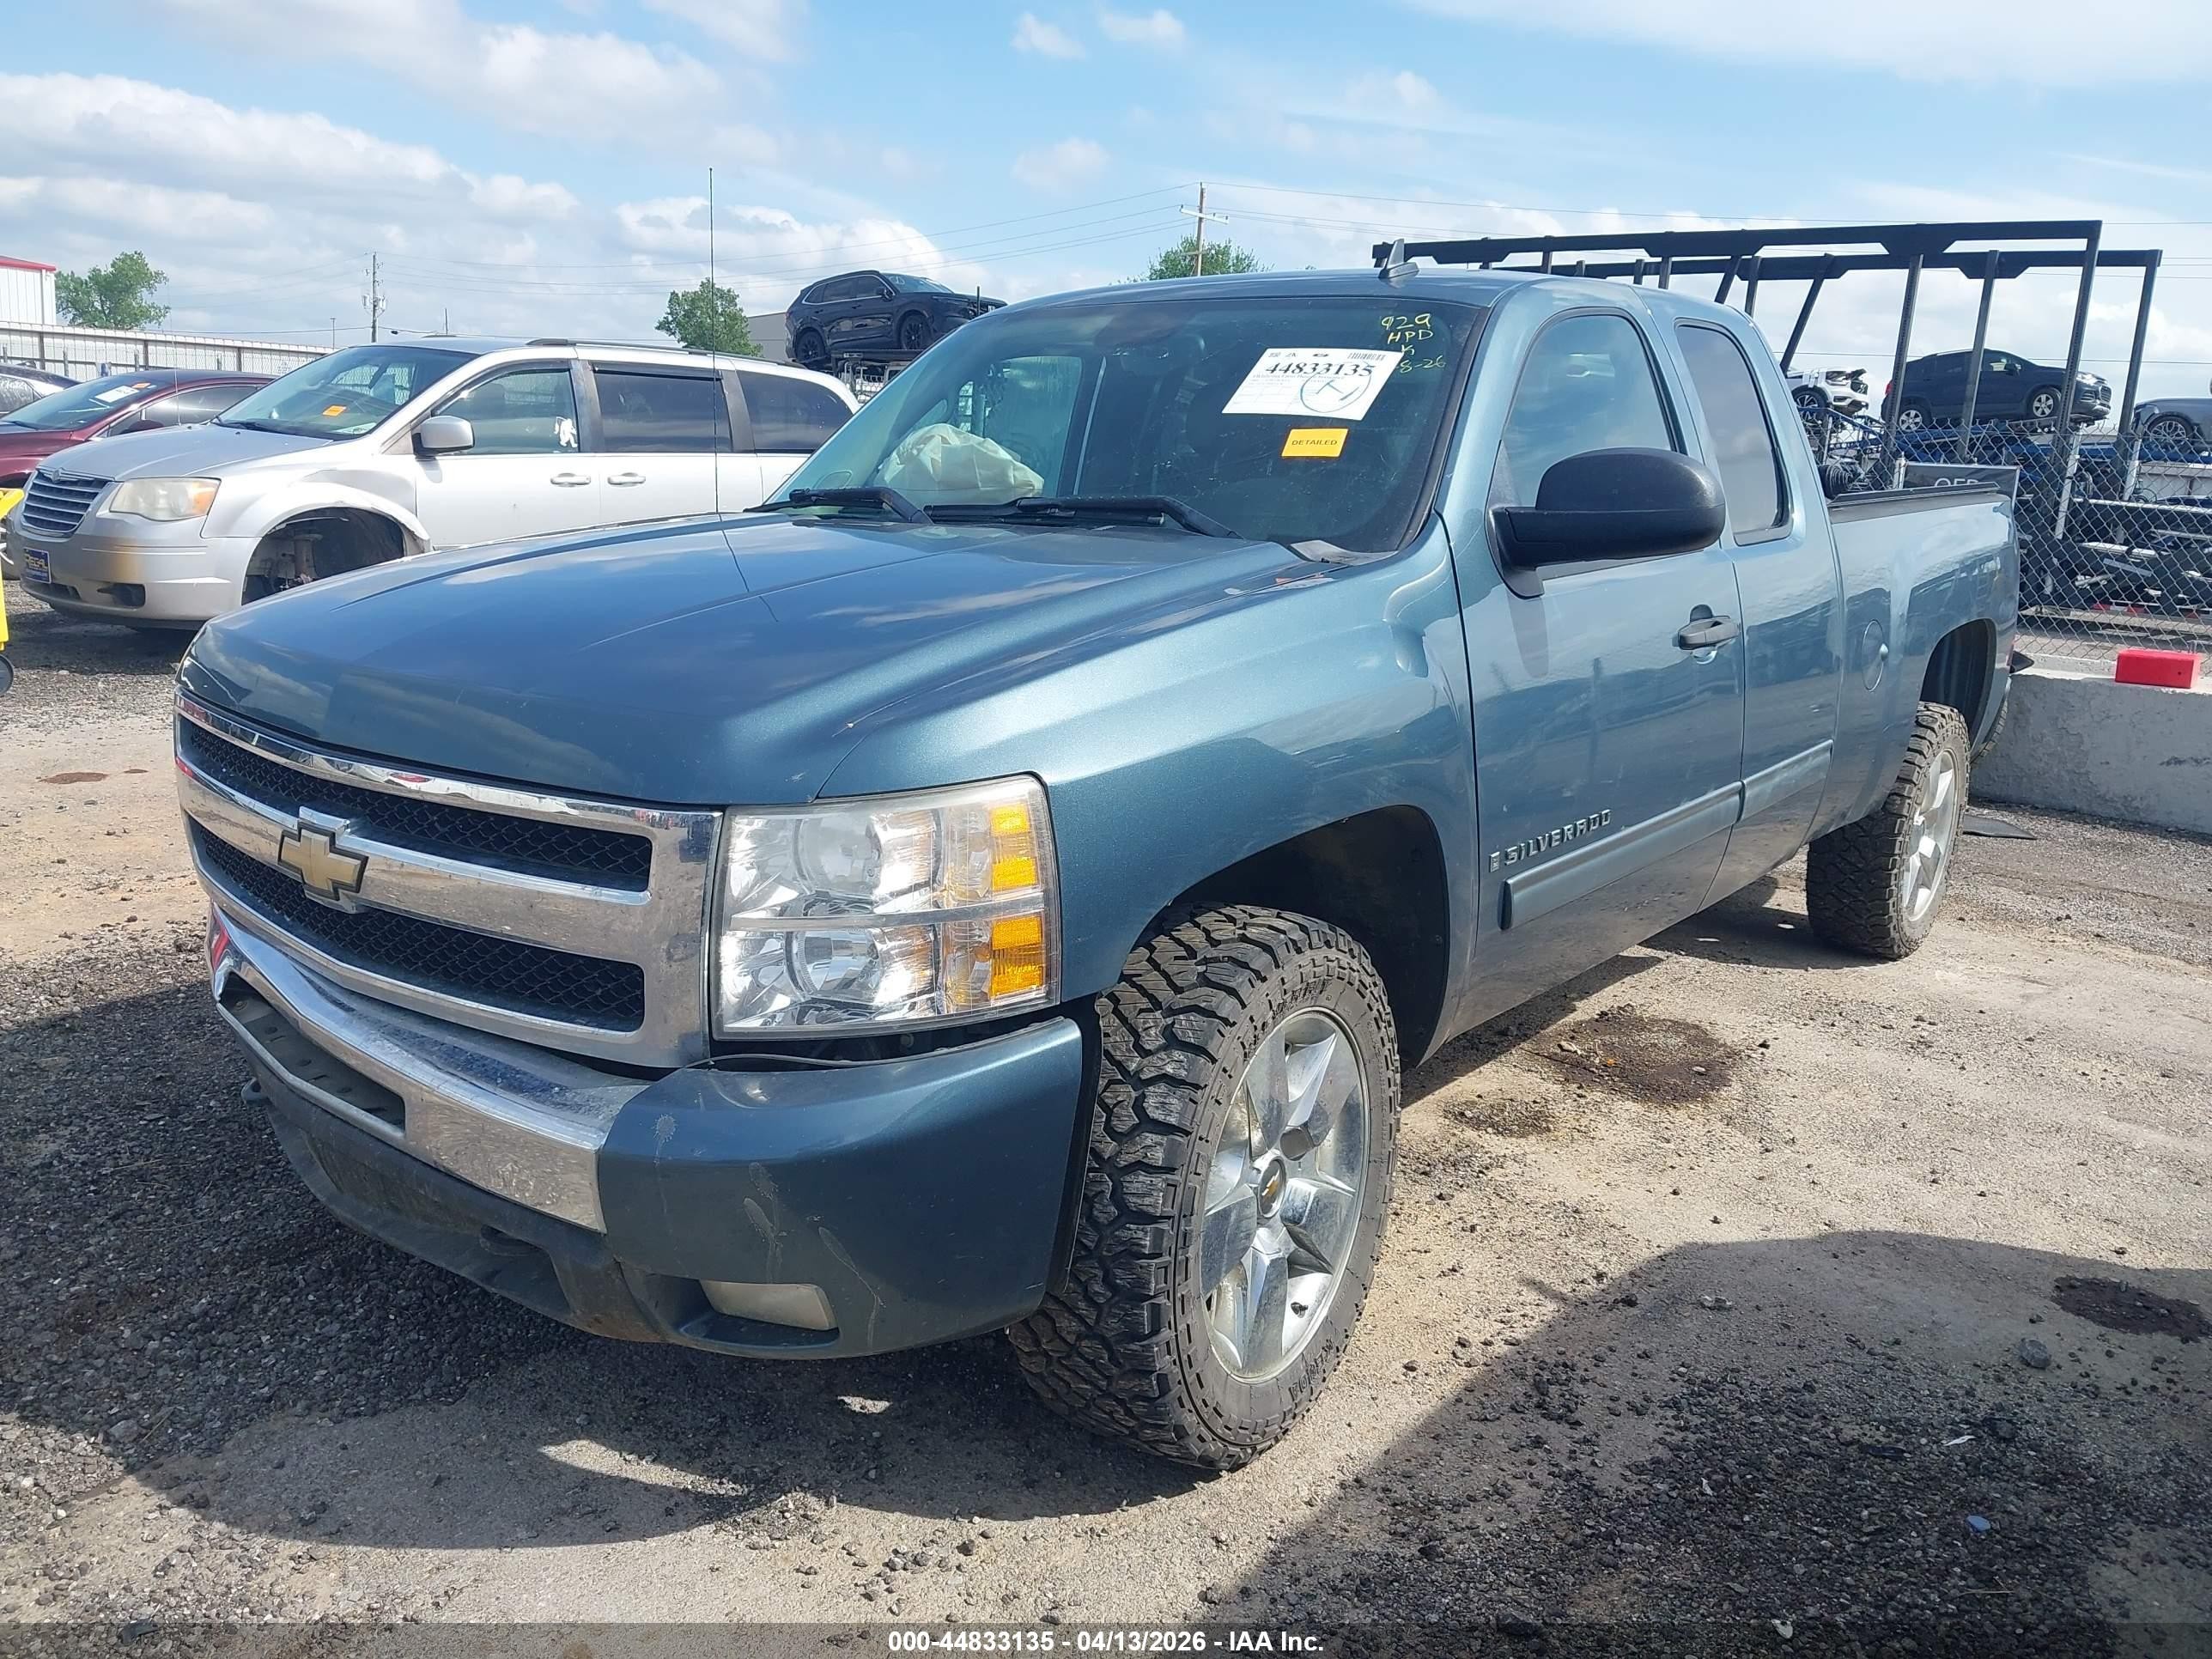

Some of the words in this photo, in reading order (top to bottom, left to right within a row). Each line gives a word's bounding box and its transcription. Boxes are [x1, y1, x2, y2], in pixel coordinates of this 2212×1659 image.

[1381, 313, 1431, 331] 929
[1387, 329, 1434, 345] HPD
[1266, 362, 1376, 377] 44833135
[1504, 809, 1612, 866] SILVERADO
